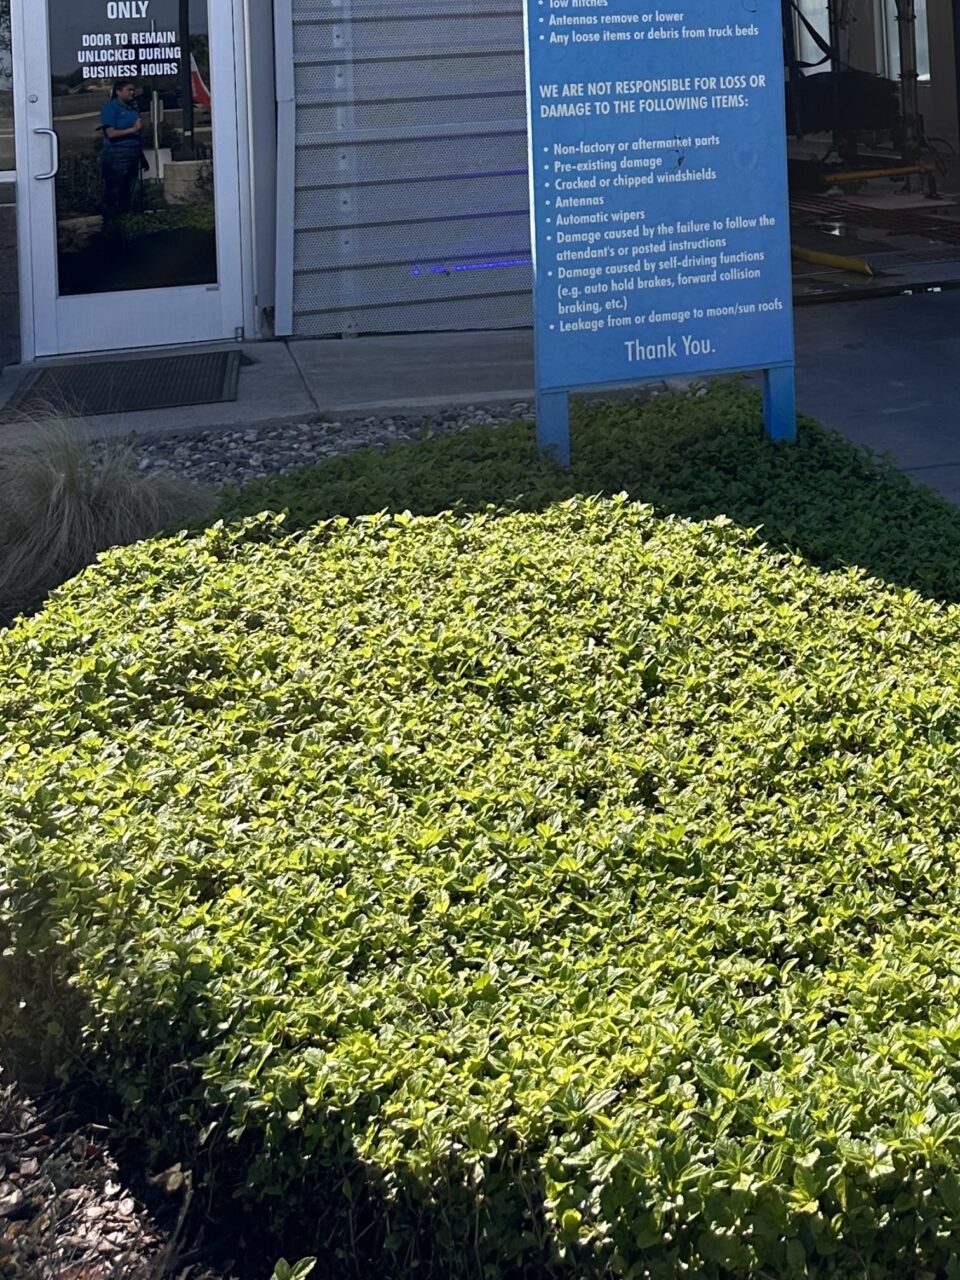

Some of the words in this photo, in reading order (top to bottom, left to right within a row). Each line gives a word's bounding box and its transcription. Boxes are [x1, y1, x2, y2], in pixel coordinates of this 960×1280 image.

[106, 1, 149, 19] ONLY
[549, 14, 598, 26] Antennas
[601, 15, 639, 24] remove
[642, 14, 652, 22] or
[656, 12, 684, 22] lower
[82, 34, 112, 46] DOOR
[114, 34, 127, 45] TO
[131, 32, 176, 45] REMAIN
[550, 32, 569, 46] Any
[572, 31, 600, 42] loose
[603, 30, 631, 41] items
[634, 30, 645, 40] or
[648, 28, 679, 40] debris
[682, 27, 705, 38] from
[708, 26, 732, 38] truck
[736, 25, 758, 36] beds
[77, 49, 135, 62] UNLOCKED
[139, 47, 181, 60] DURING
[82, 65, 137, 78] BUSINESS
[141, 63, 178, 76] HOURS
[539, 85, 559, 98] WE
[562, 84, 584, 97] ARE
[588, 83, 611, 96] NOT
[615, 79, 691, 94] RESPONSIBLE
[694, 78, 716, 90] FOR
[720, 76, 746, 89] LOSS
[750, 75, 765, 88] OR
[540, 103, 591, 118] DAMAGE
[595, 102, 610, 115] TO
[613, 101, 635, 114] THE
[639, 96, 708, 112] FOLLOWING
[711, 95, 748, 108] ITEMS:
[554, 141, 615, 156] Non-factory
[618, 141, 628, 151] or
[632, 138, 692, 151] aftermarket
[695, 136, 720, 149] parts
[554, 159, 617, 172] Pre-existing
[620, 156, 662, 170] damage
[555, 178, 596, 190] Cracked
[599, 178, 610, 187] or
[613, 174, 654, 188] chipped
[657, 169, 716, 183] windshields
[555, 195, 604, 208] Antennas
[556, 213, 608, 226] Automatic
[612, 210, 645, 224] wipers
[556, 230, 601, 245] Damage
[604, 226, 639, 240] caused
[643, 225, 654, 239] by
[657, 224, 674, 236] the
[677, 221, 710, 234] failure
[713, 220, 723, 231] to
[726, 218, 757, 230] follow
[759, 215, 775, 227] the
[556, 247, 615, 261] attendant's
[618, 247, 629, 256] or
[632, 241, 666, 257] posted
[669, 237, 726, 251] instructions
[558, 265, 602, 280] Damage
[605, 261, 641, 275] caused
[644, 260, 656, 274] by
[659, 255, 717, 270] self-driving
[720, 250, 765, 264] functions
[557, 285, 581, 299] (e.g.
[585, 283, 608, 294] auto
[611, 279, 635, 293] hold
[637, 275, 675, 290] brakes,
[678, 272, 717, 286] forward
[720, 268, 761, 282] collision
[558, 299, 603, 316] braking,
[605, 296, 628, 310] etc.)
[560, 318, 604, 333] Leakage
[607, 316, 632, 328] from
[635, 316, 645, 325] or
[648, 309, 690, 323] damage
[693, 309, 704, 319] to
[706, 302, 755, 318] moon/sun
[758, 298, 783, 312] roofs
[625, 336, 677, 362] Thank
[682, 335, 716, 356] You.
